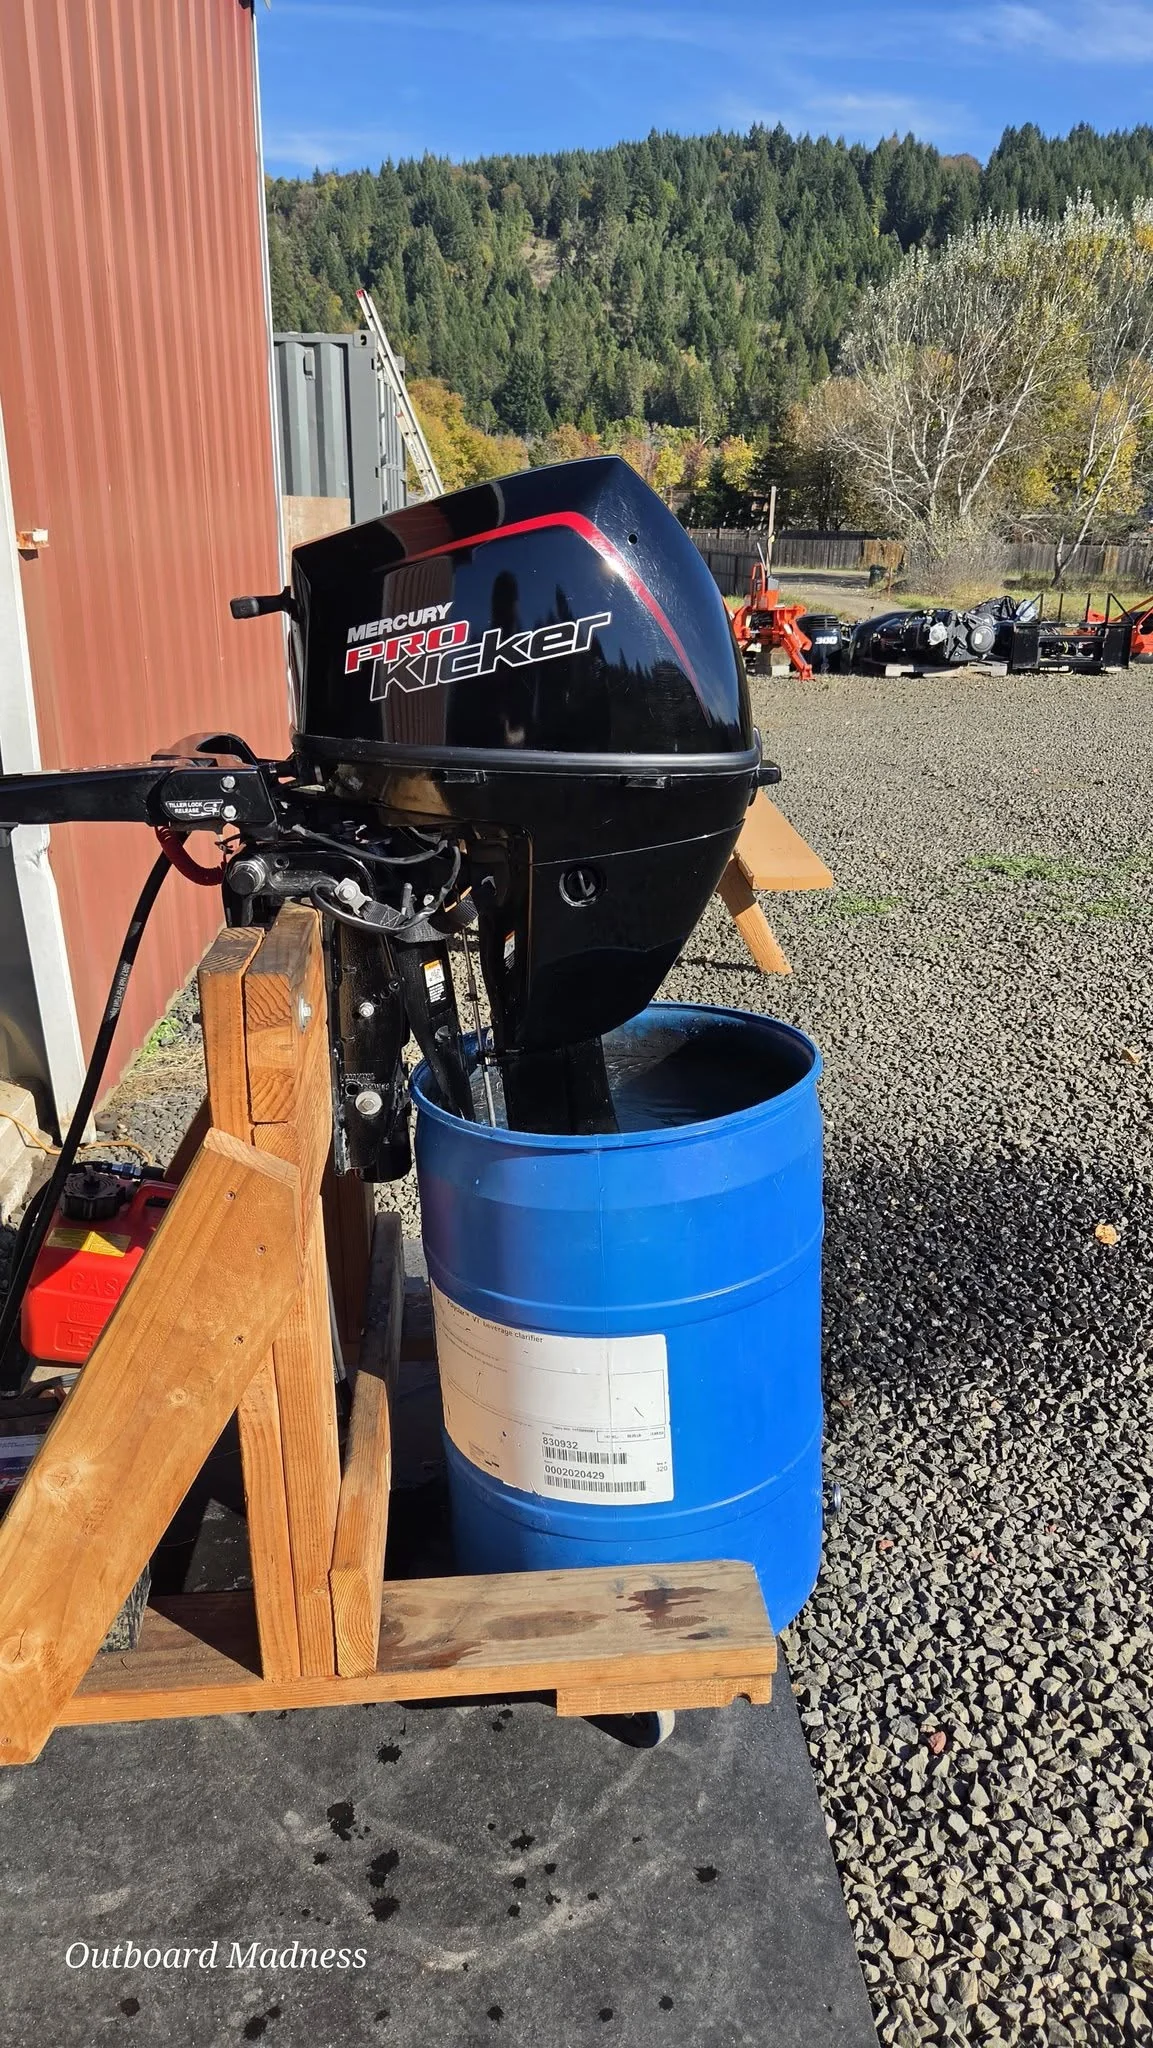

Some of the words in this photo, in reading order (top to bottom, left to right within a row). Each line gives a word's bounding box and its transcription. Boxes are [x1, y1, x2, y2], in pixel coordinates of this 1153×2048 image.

[347, 602, 453, 643] MERCURY
[345, 620, 469, 674] PRO
[370, 612, 612, 701] Kicker
[483, 1321, 513, 1336] beverage
[514, 1331, 543, 1343] clarifier
[542, 1436, 578, 1450] 830932
[544, 1464, 605, 1480] 0002020429
